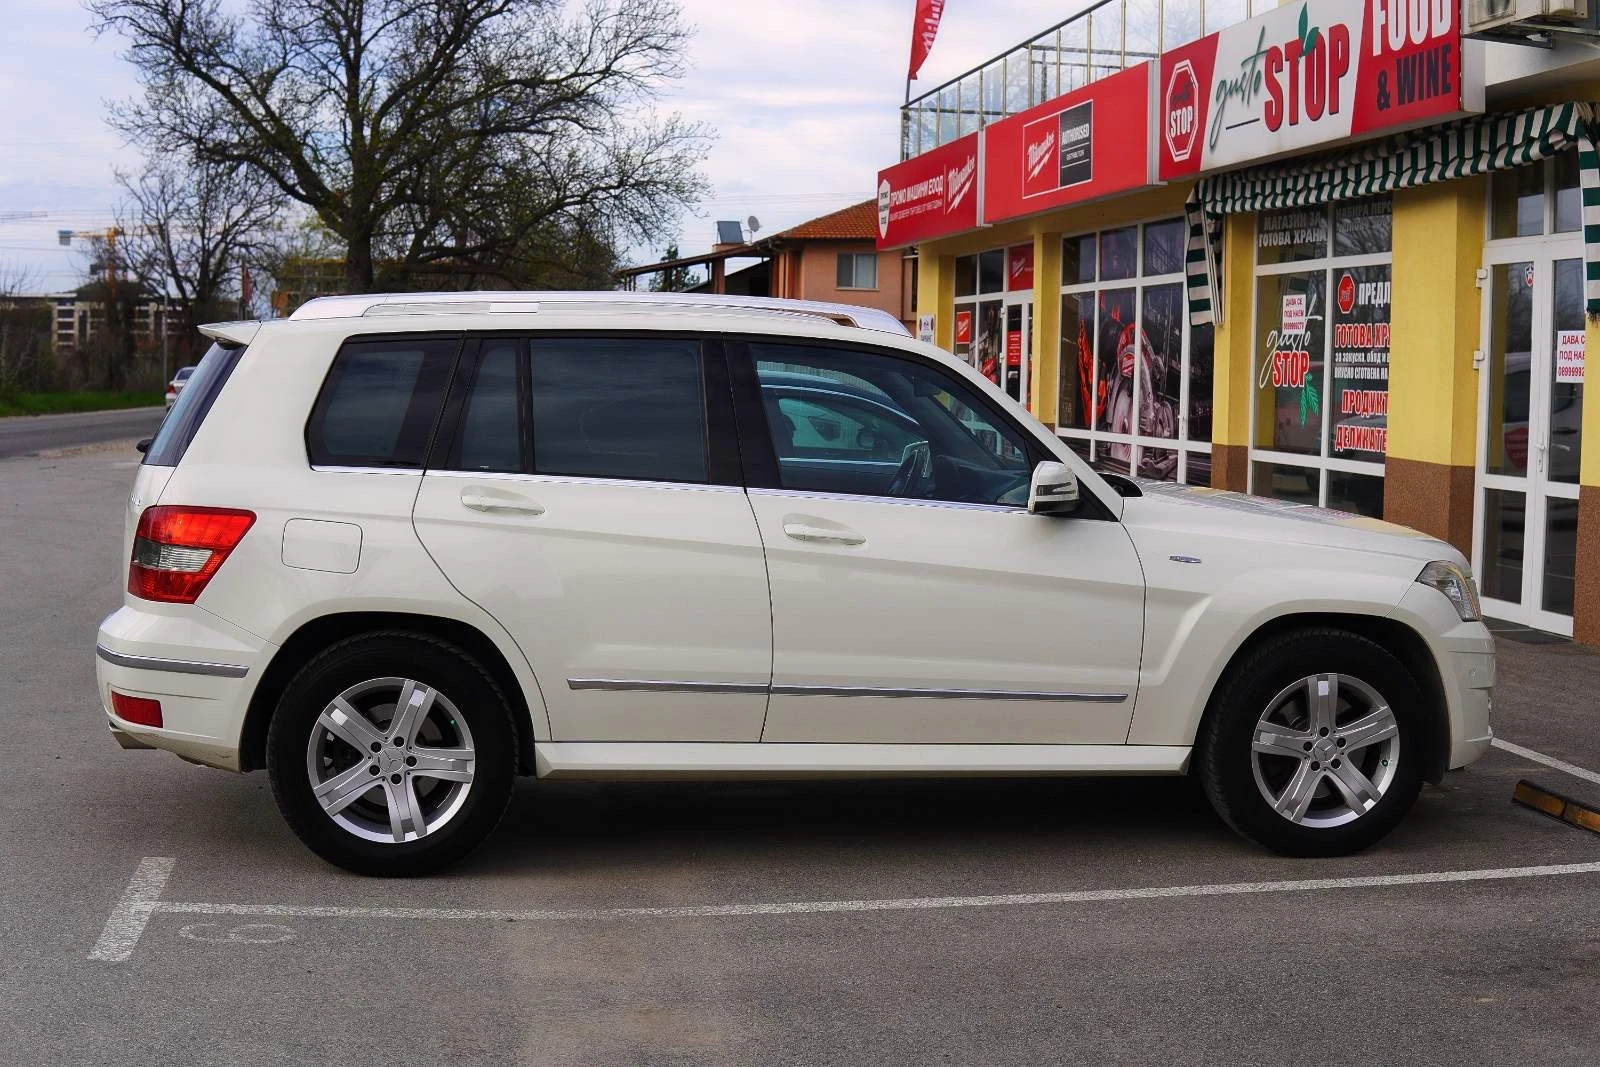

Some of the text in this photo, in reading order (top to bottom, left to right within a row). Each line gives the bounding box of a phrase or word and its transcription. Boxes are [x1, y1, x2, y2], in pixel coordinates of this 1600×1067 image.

[1372, 0, 1451, 56] FOOD
[1209, 23, 1350, 151] gusto STOP
[1376, 43, 1452, 111] & WINE
[1061, 123, 1090, 145] AUTHORISED
[1170, 105, 1193, 138] STOP
[1264, 212, 1307, 231] МАГАЗИН
[1259, 226, 1327, 247] ГОТОВА ХРАНА
[1335, 323, 1372, 348] ГОТОВА
[1562, 335, 1579, 345] ДАВА
[1559, 350, 1573, 361] ПОД
[1272, 350, 1310, 387] STOP
